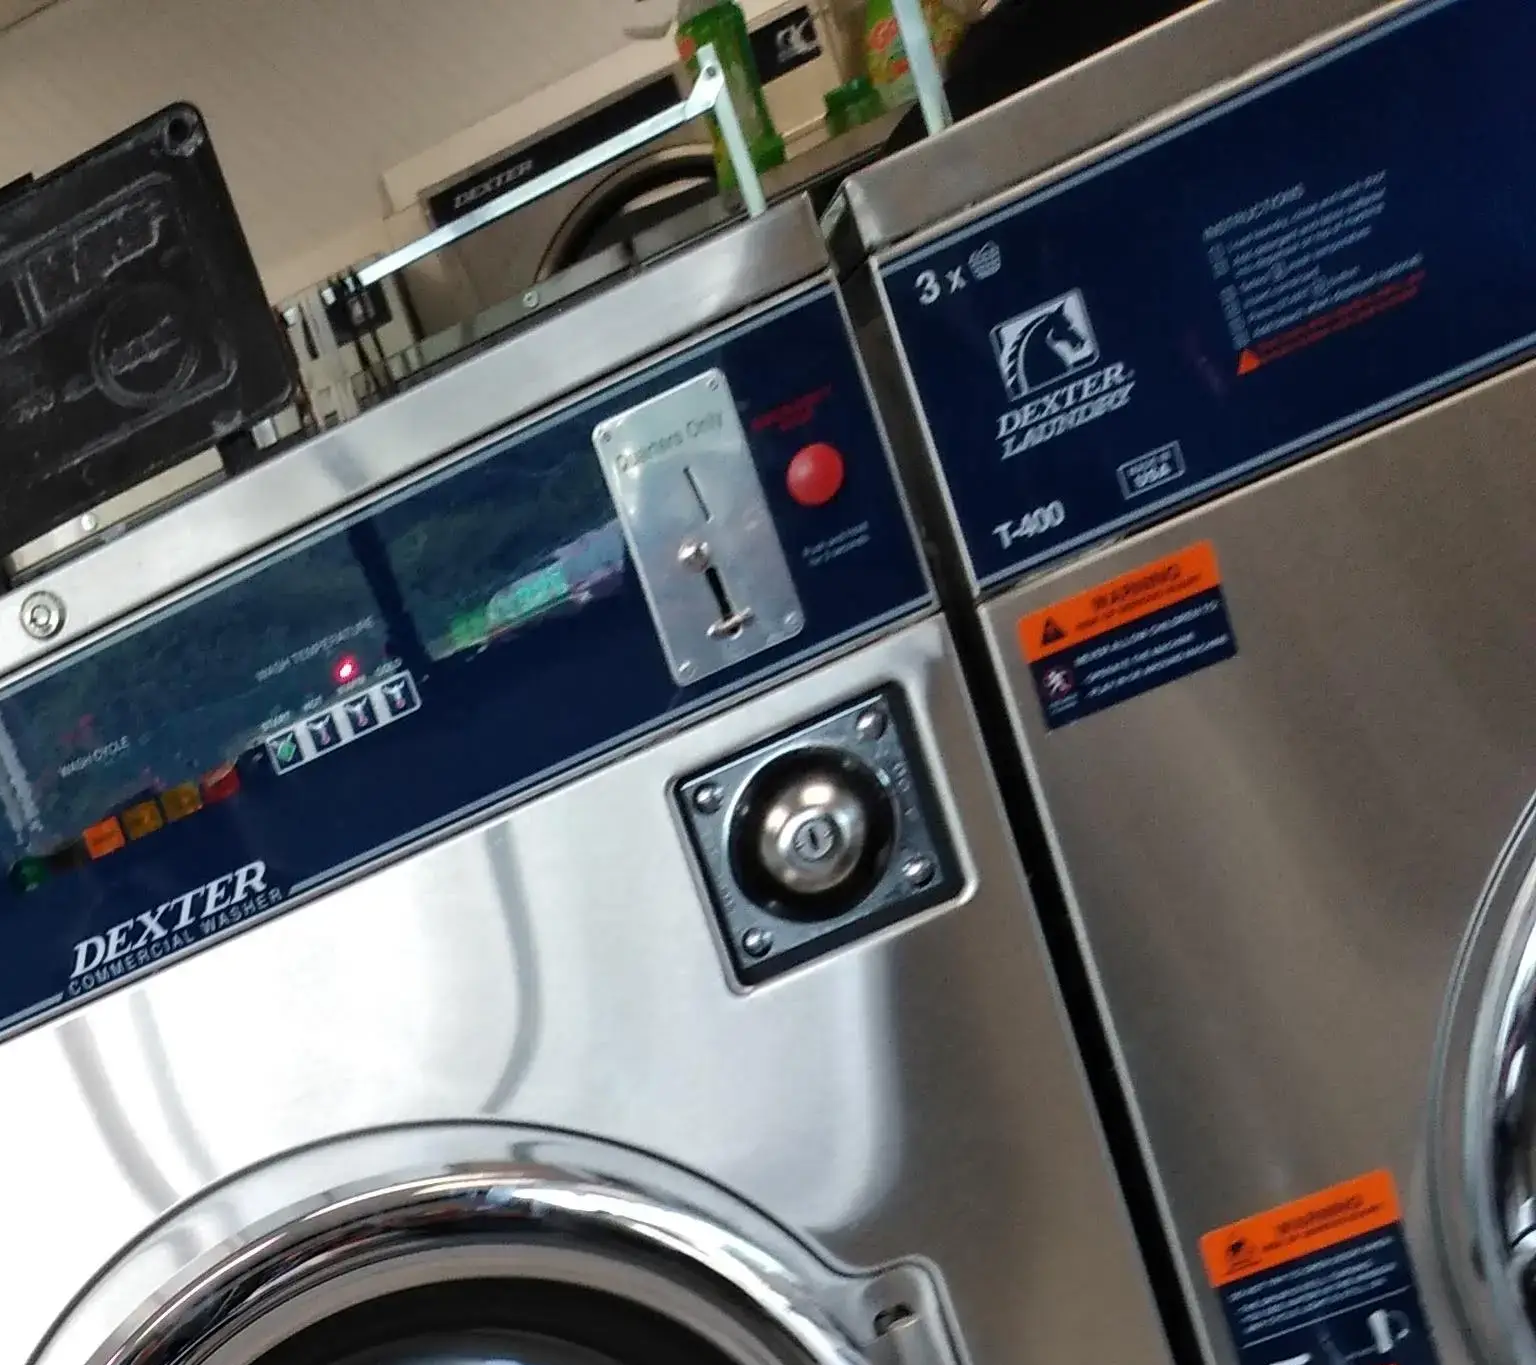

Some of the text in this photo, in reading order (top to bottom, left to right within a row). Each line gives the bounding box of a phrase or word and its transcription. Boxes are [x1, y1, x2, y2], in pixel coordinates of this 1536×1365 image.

[915, 269, 942, 305] 3
[995, 362, 1126, 441] DEXTER
[1001, 380, 1135, 461] LAUNDRY
[992, 501, 1064, 550] T-400
[67, 887, 284, 997] COMMERCIAL WASHER
[70, 860, 267, 979] DEXTER
